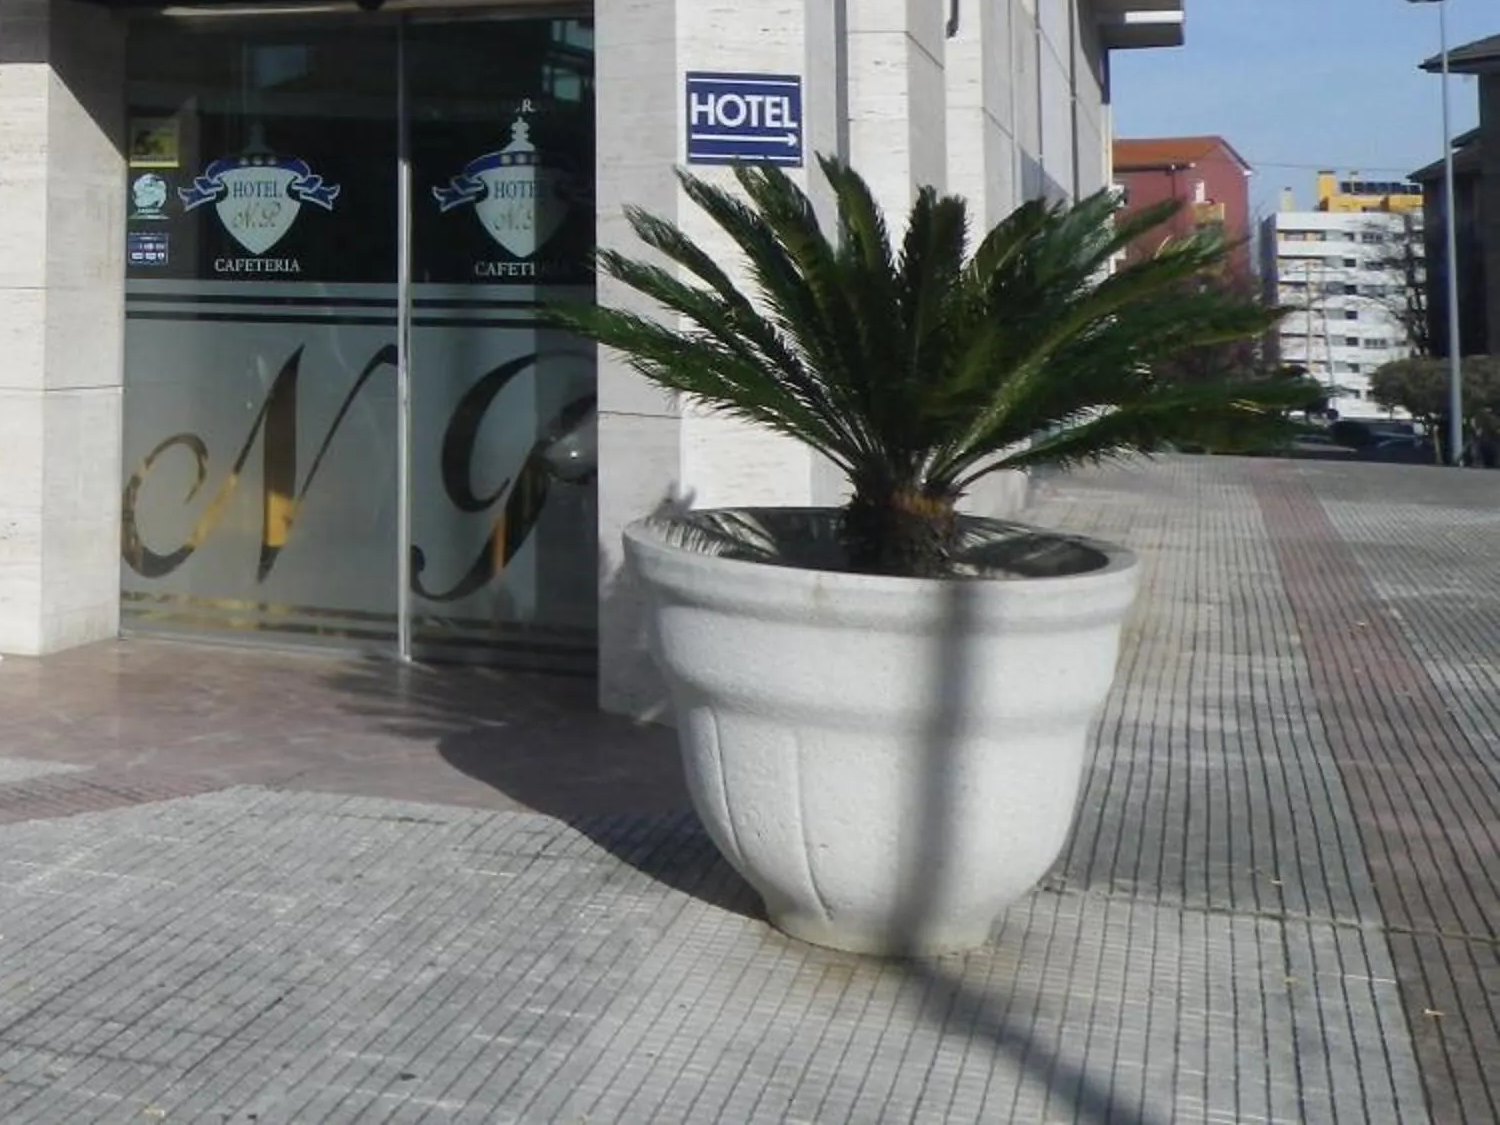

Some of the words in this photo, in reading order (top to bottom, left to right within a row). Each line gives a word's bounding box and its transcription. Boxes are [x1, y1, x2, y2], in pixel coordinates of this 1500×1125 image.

[690, 93, 798, 127] HOTEL
[233, 180, 283, 197] HOTEL
[214, 258, 301, 272] CAFETERIA
